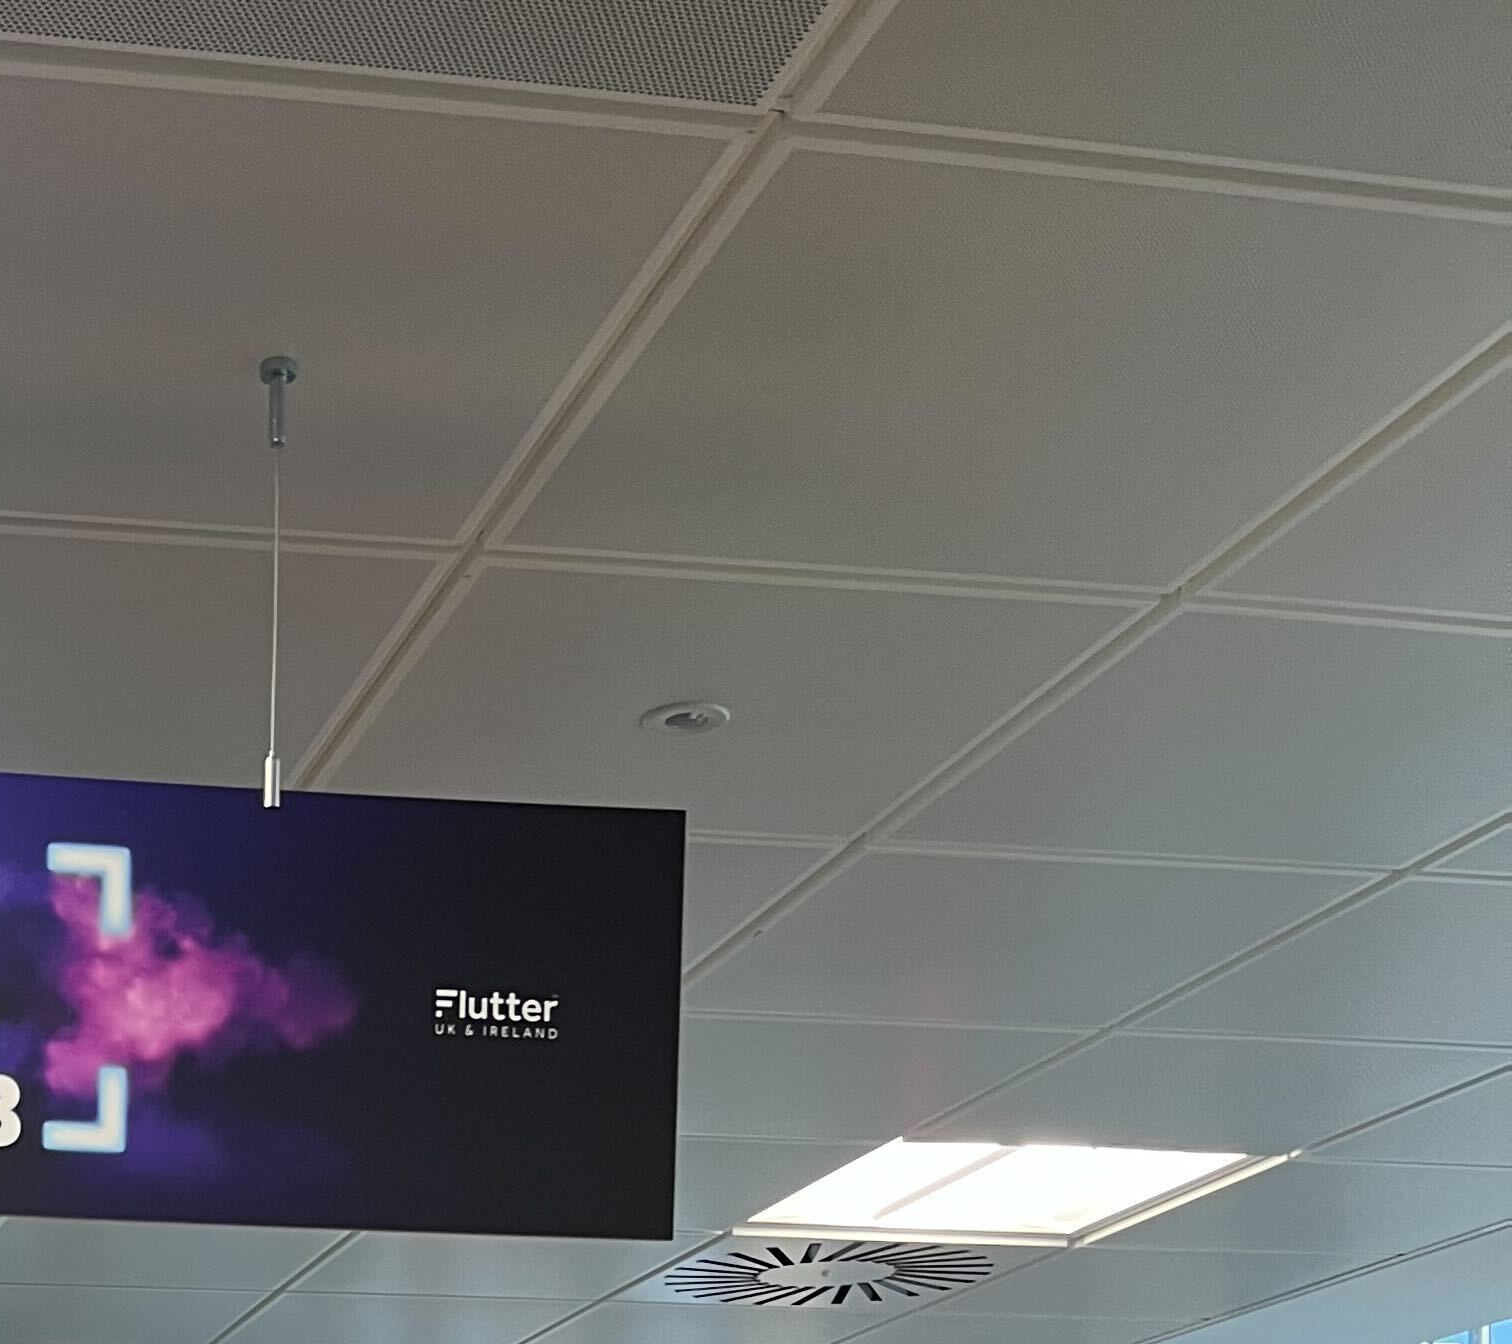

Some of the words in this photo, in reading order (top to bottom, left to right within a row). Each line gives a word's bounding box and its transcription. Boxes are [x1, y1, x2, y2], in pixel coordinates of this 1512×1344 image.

[434, 988, 560, 1023] Flutter
[434, 1022, 456, 1036] UK
[464, 1023, 475, 1037] &
[482, 1025, 559, 1040] IRELAND
